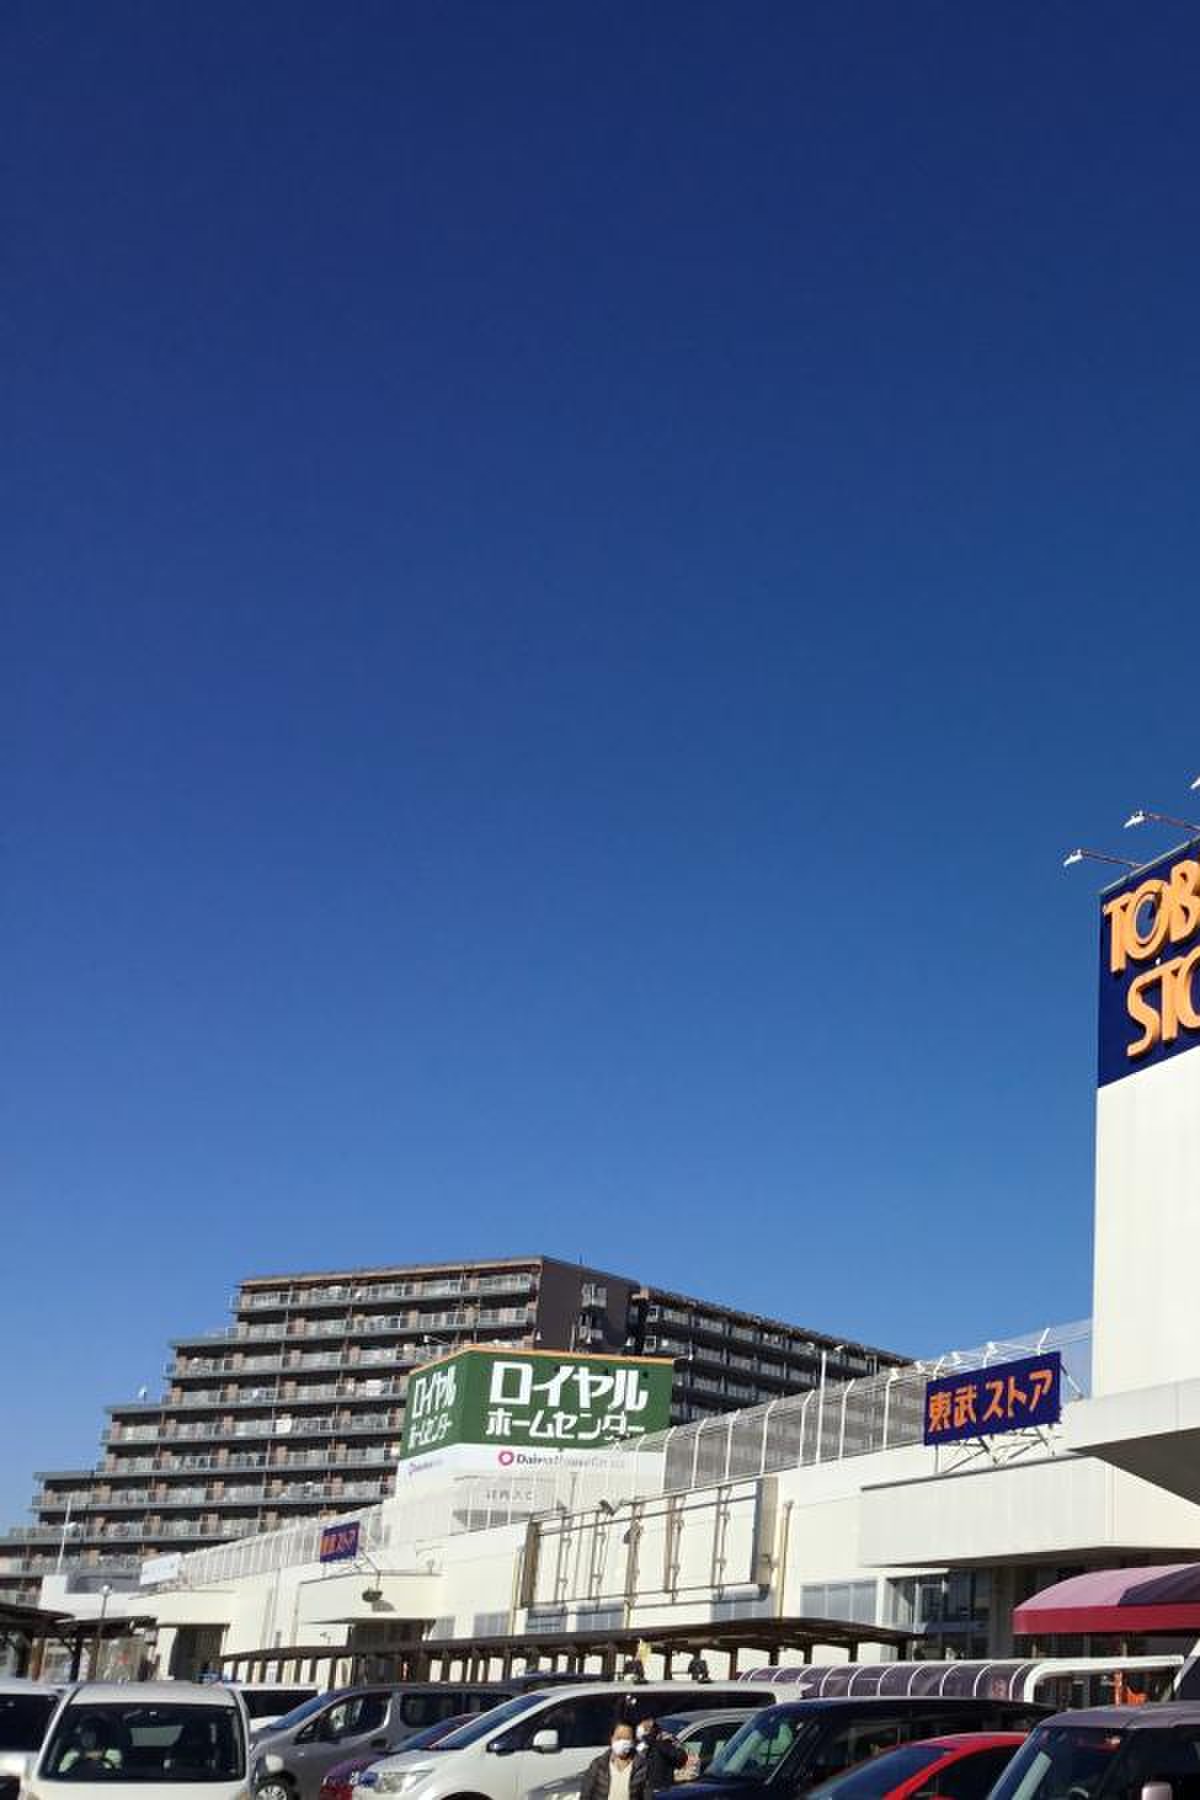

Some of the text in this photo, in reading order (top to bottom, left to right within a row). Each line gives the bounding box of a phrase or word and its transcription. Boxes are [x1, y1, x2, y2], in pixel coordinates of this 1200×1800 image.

[489, 1360, 649, 1412] ロイヤル
[928, 1369, 1053, 1432] 東武ストア
[485, 1409, 646, 1442] ホームセンター
